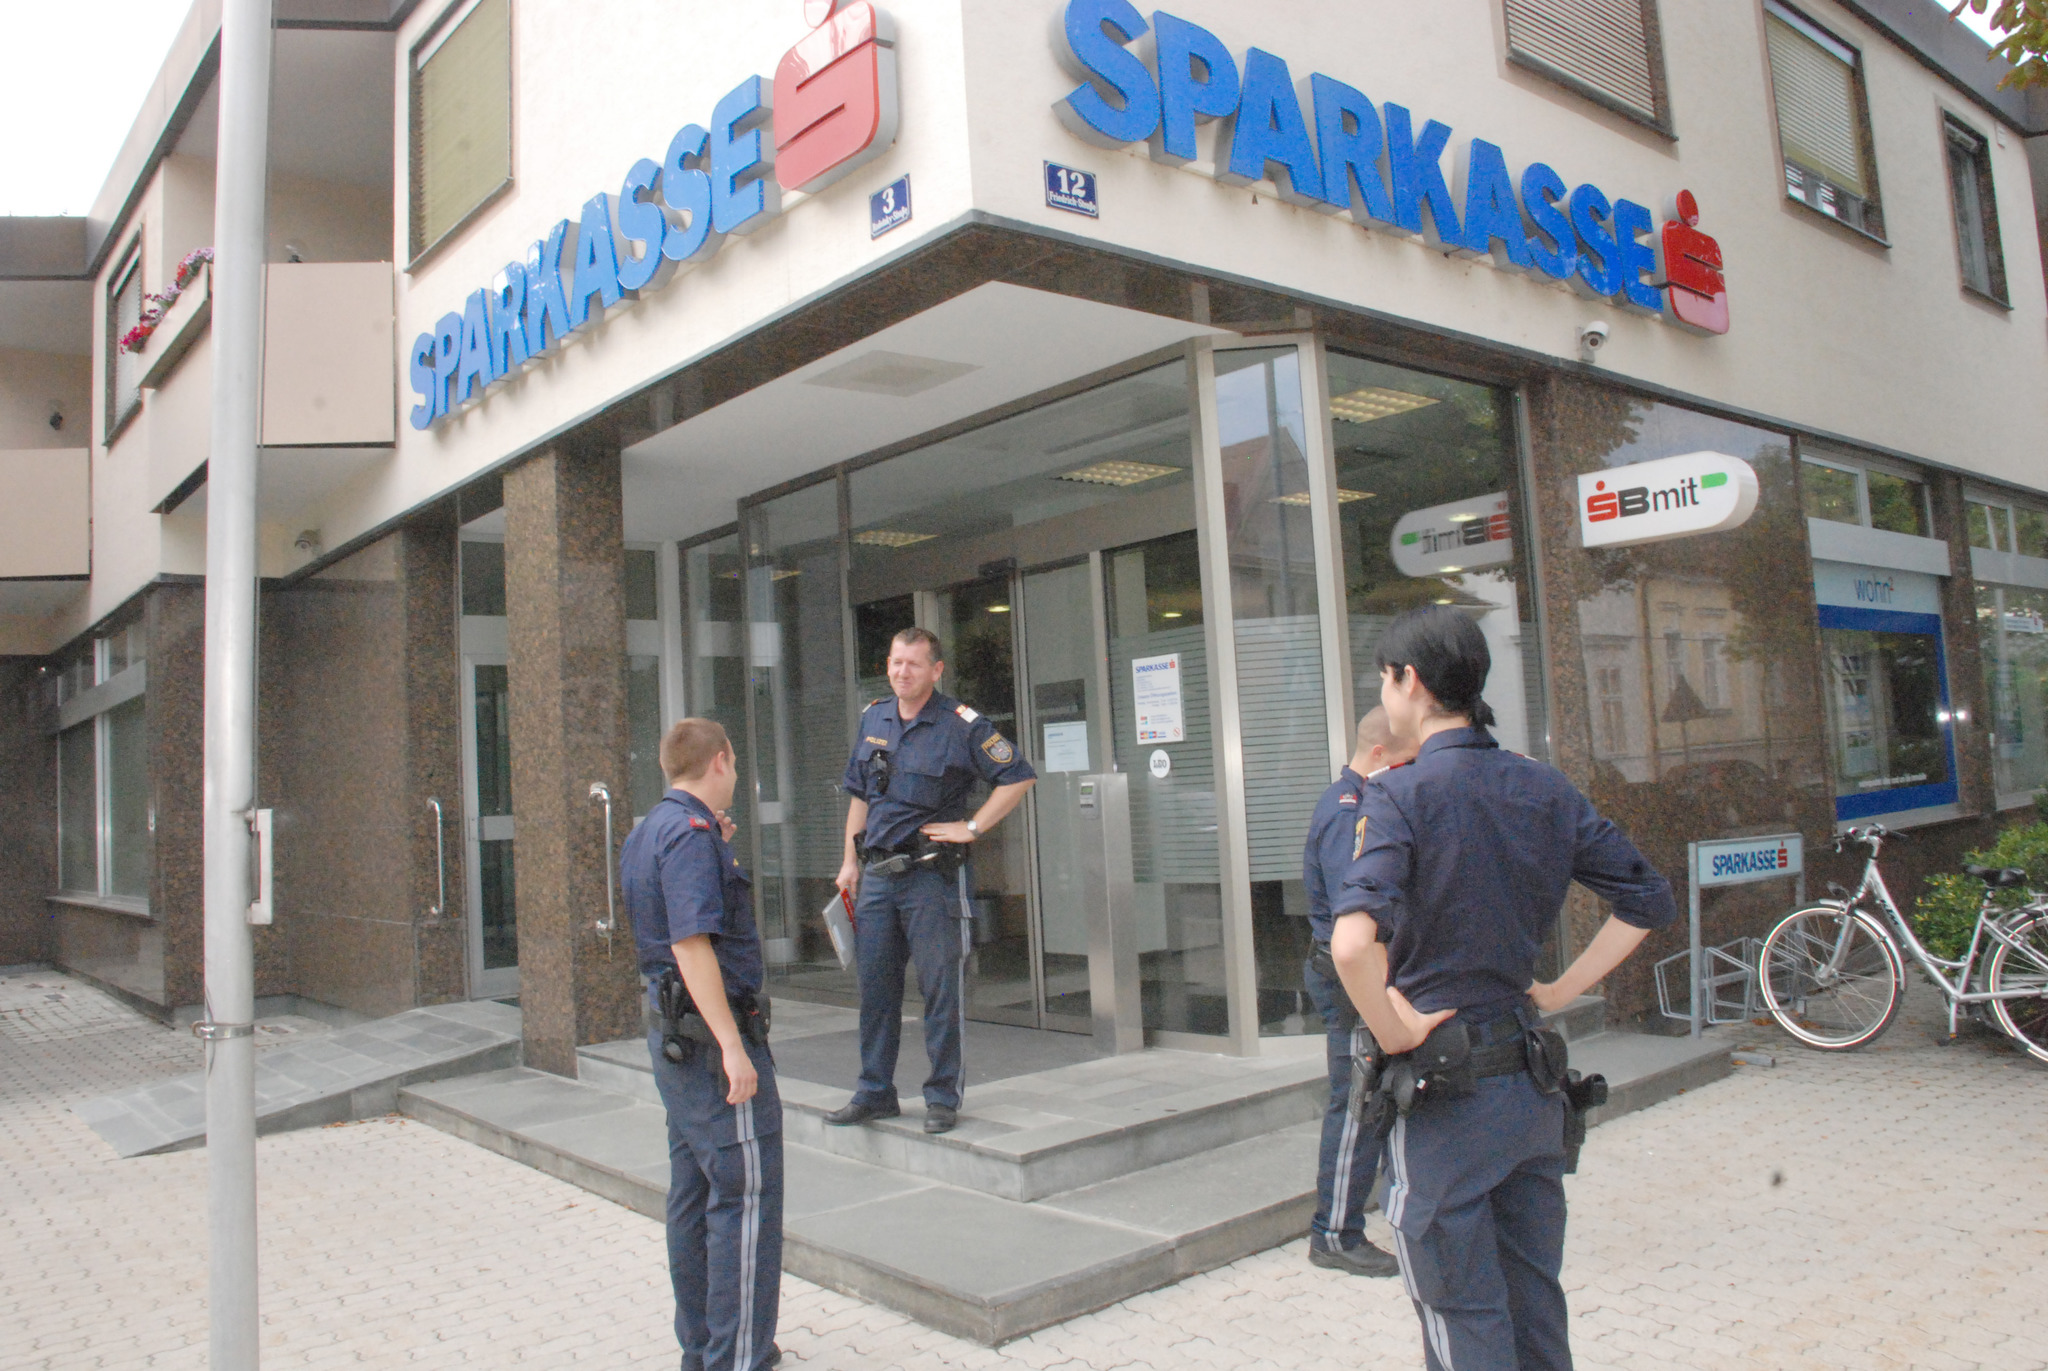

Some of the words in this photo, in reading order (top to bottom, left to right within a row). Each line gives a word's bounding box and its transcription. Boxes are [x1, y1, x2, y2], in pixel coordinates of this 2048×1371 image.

[1058, 0, 1663, 312] SPARKASSE
[1057, 169, 1086, 198] 12
[882, 187, 895, 215] 3
[410, 74, 765, 430] SPARKASSE
[1135, 662, 1169, 674] SPARKASSE
[1712, 849, 1777, 877] SPARKASSE
